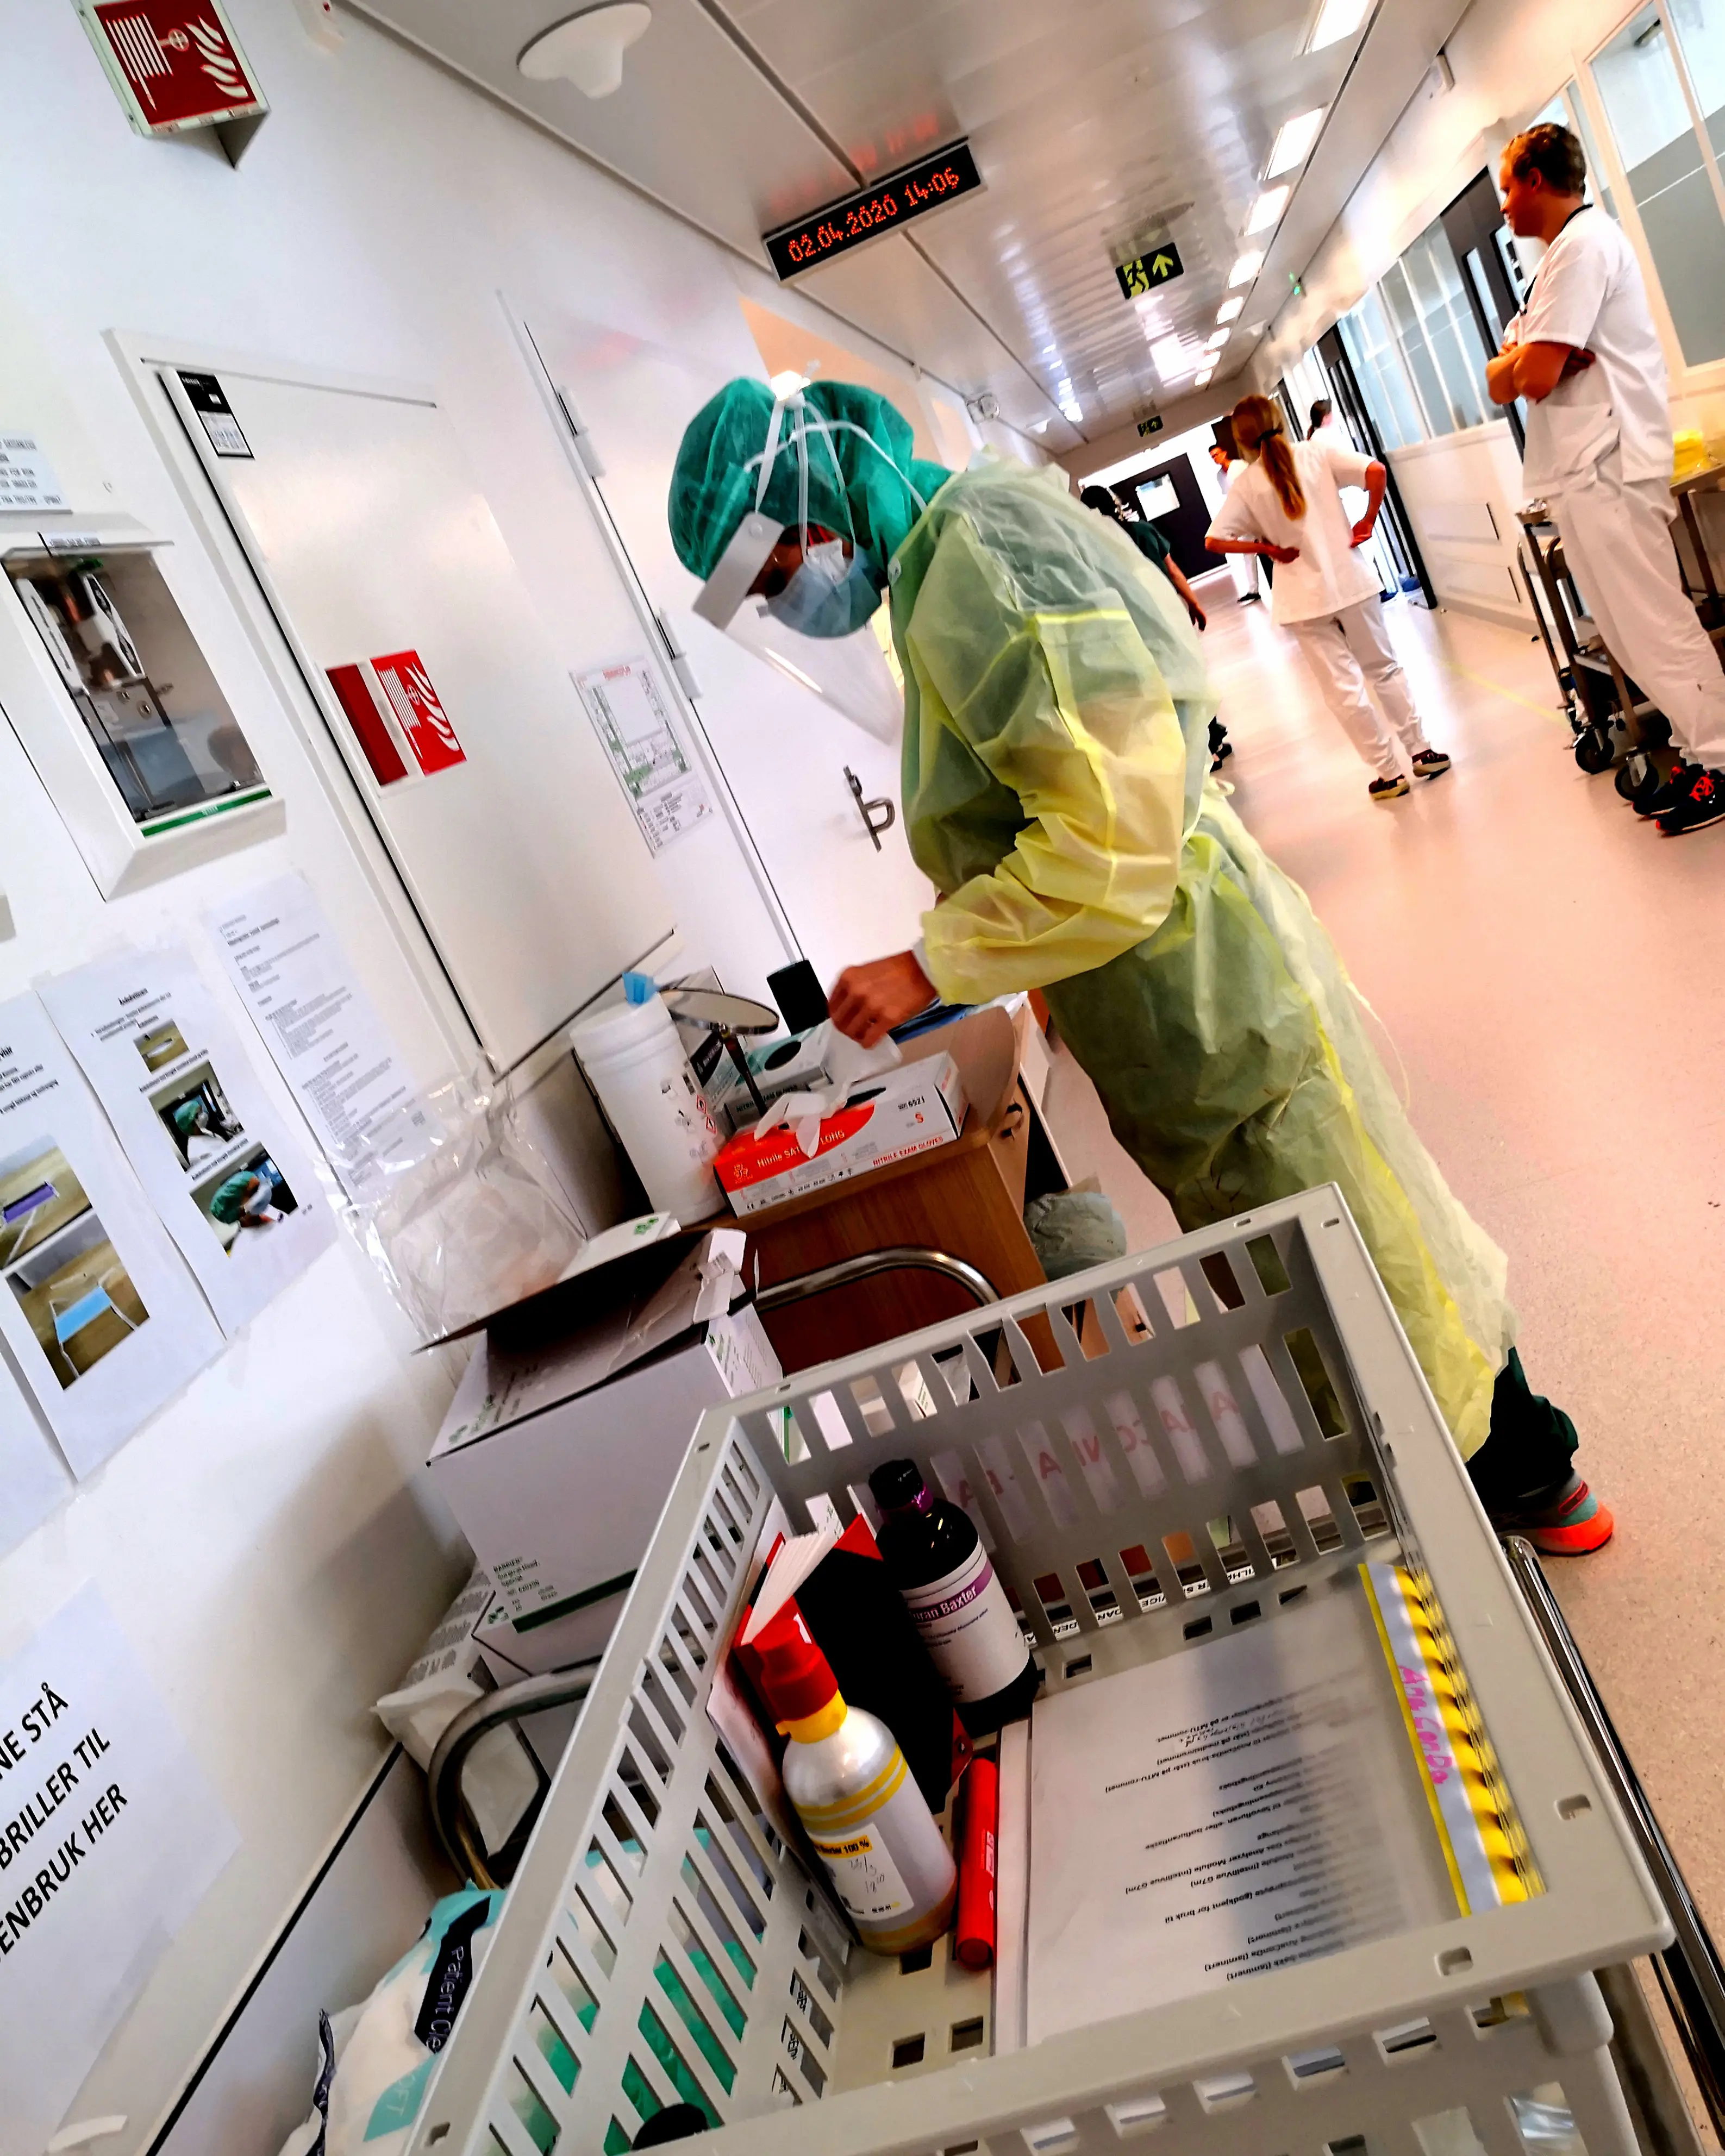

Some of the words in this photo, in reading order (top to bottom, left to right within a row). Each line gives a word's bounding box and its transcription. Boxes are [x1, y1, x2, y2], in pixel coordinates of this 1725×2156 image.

[788, 193, 898, 261] 02.04.2020
[904, 167, 959, 206] 14:06
[915, 1112, 924, 1123] S
[757, 1150, 783, 1168] Nitrile
[820, 1130, 845, 1145] LONG
[939, 1583, 978, 1615] Baxter
[21, 1682, 69, 1744] STÅ
[0, 1762, 79, 1870] BRILLER
[73, 1727, 111, 1770] TIL
[0, 1831, 86, 1956] ENBRUK
[81, 1783, 128, 1845] HER
[843, 1844, 859, 1854] 100
[859, 1839, 870, 1848] %
[435, 1946, 465, 2014] Patient
